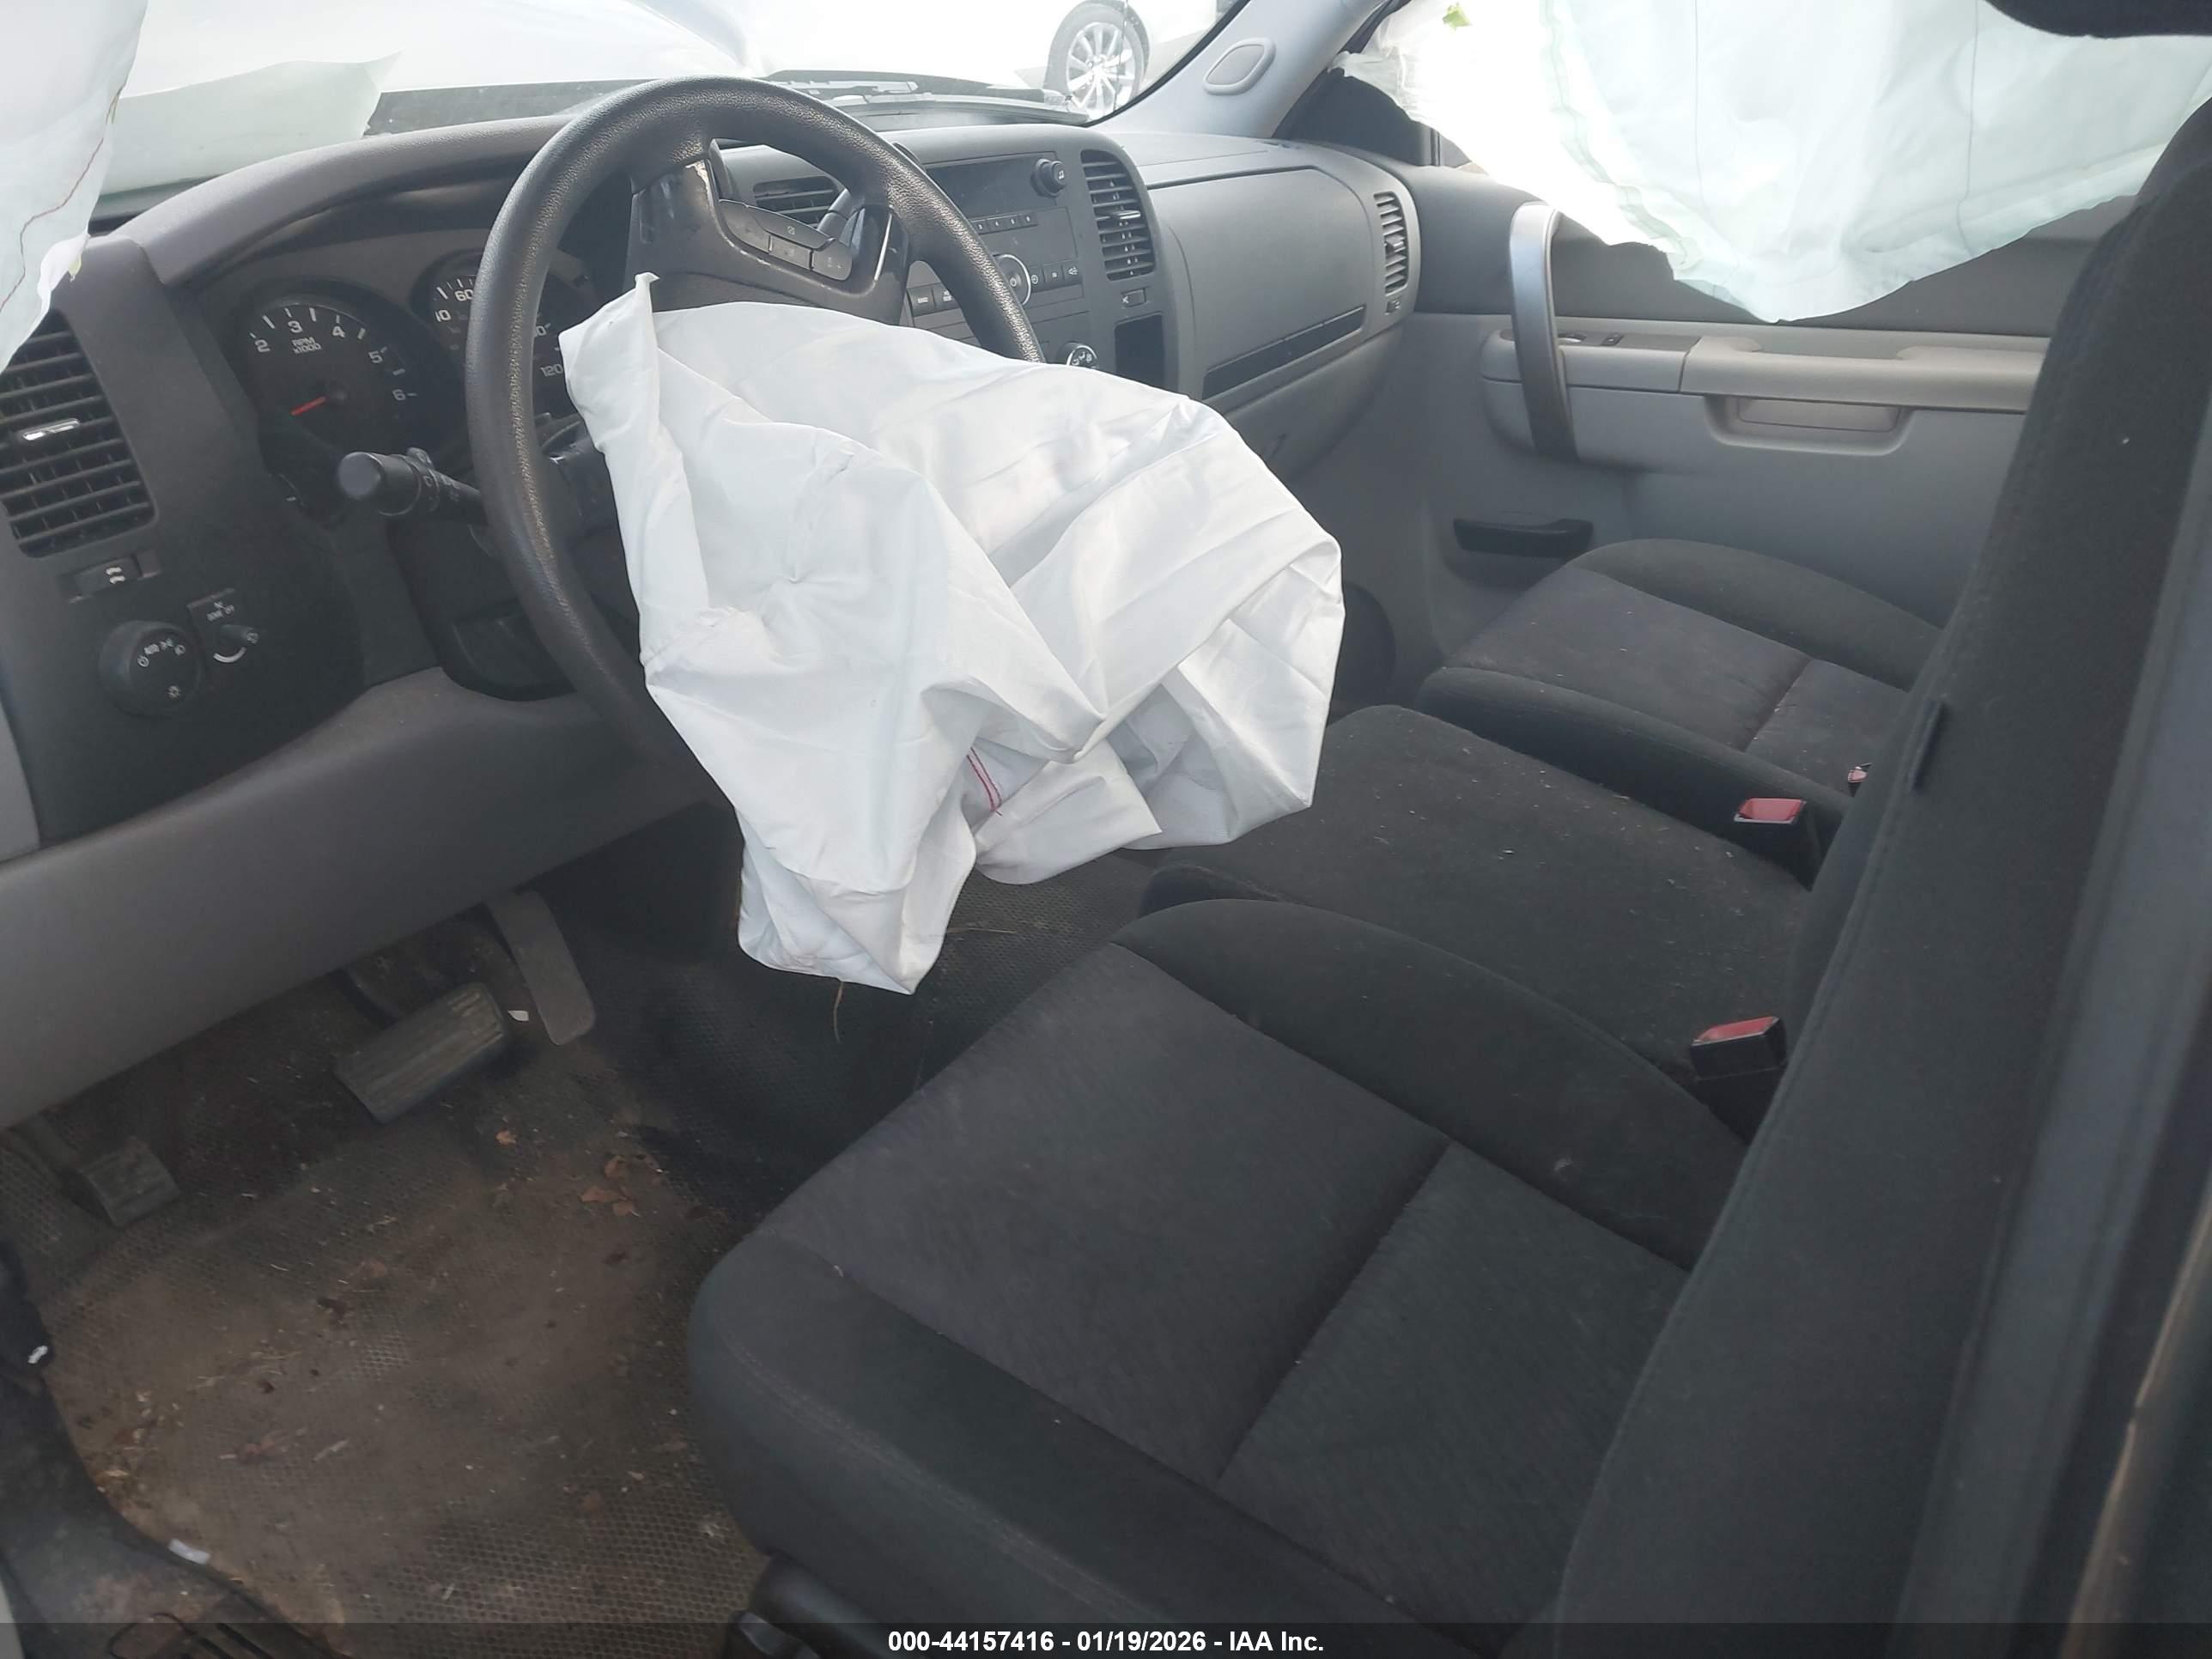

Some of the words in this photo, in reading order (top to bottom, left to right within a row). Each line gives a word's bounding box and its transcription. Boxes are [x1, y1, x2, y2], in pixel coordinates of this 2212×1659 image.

[454, 289, 474, 301] 60
[288, 320, 303, 333] 3
[331, 325, 345, 337] 4
[254, 339, 270, 353] 2
[291, 336, 316, 347] RPM
[368, 350, 383, 364] 5
[539, 363, 563, 377] 120
[392, 389, 406, 401] 6
